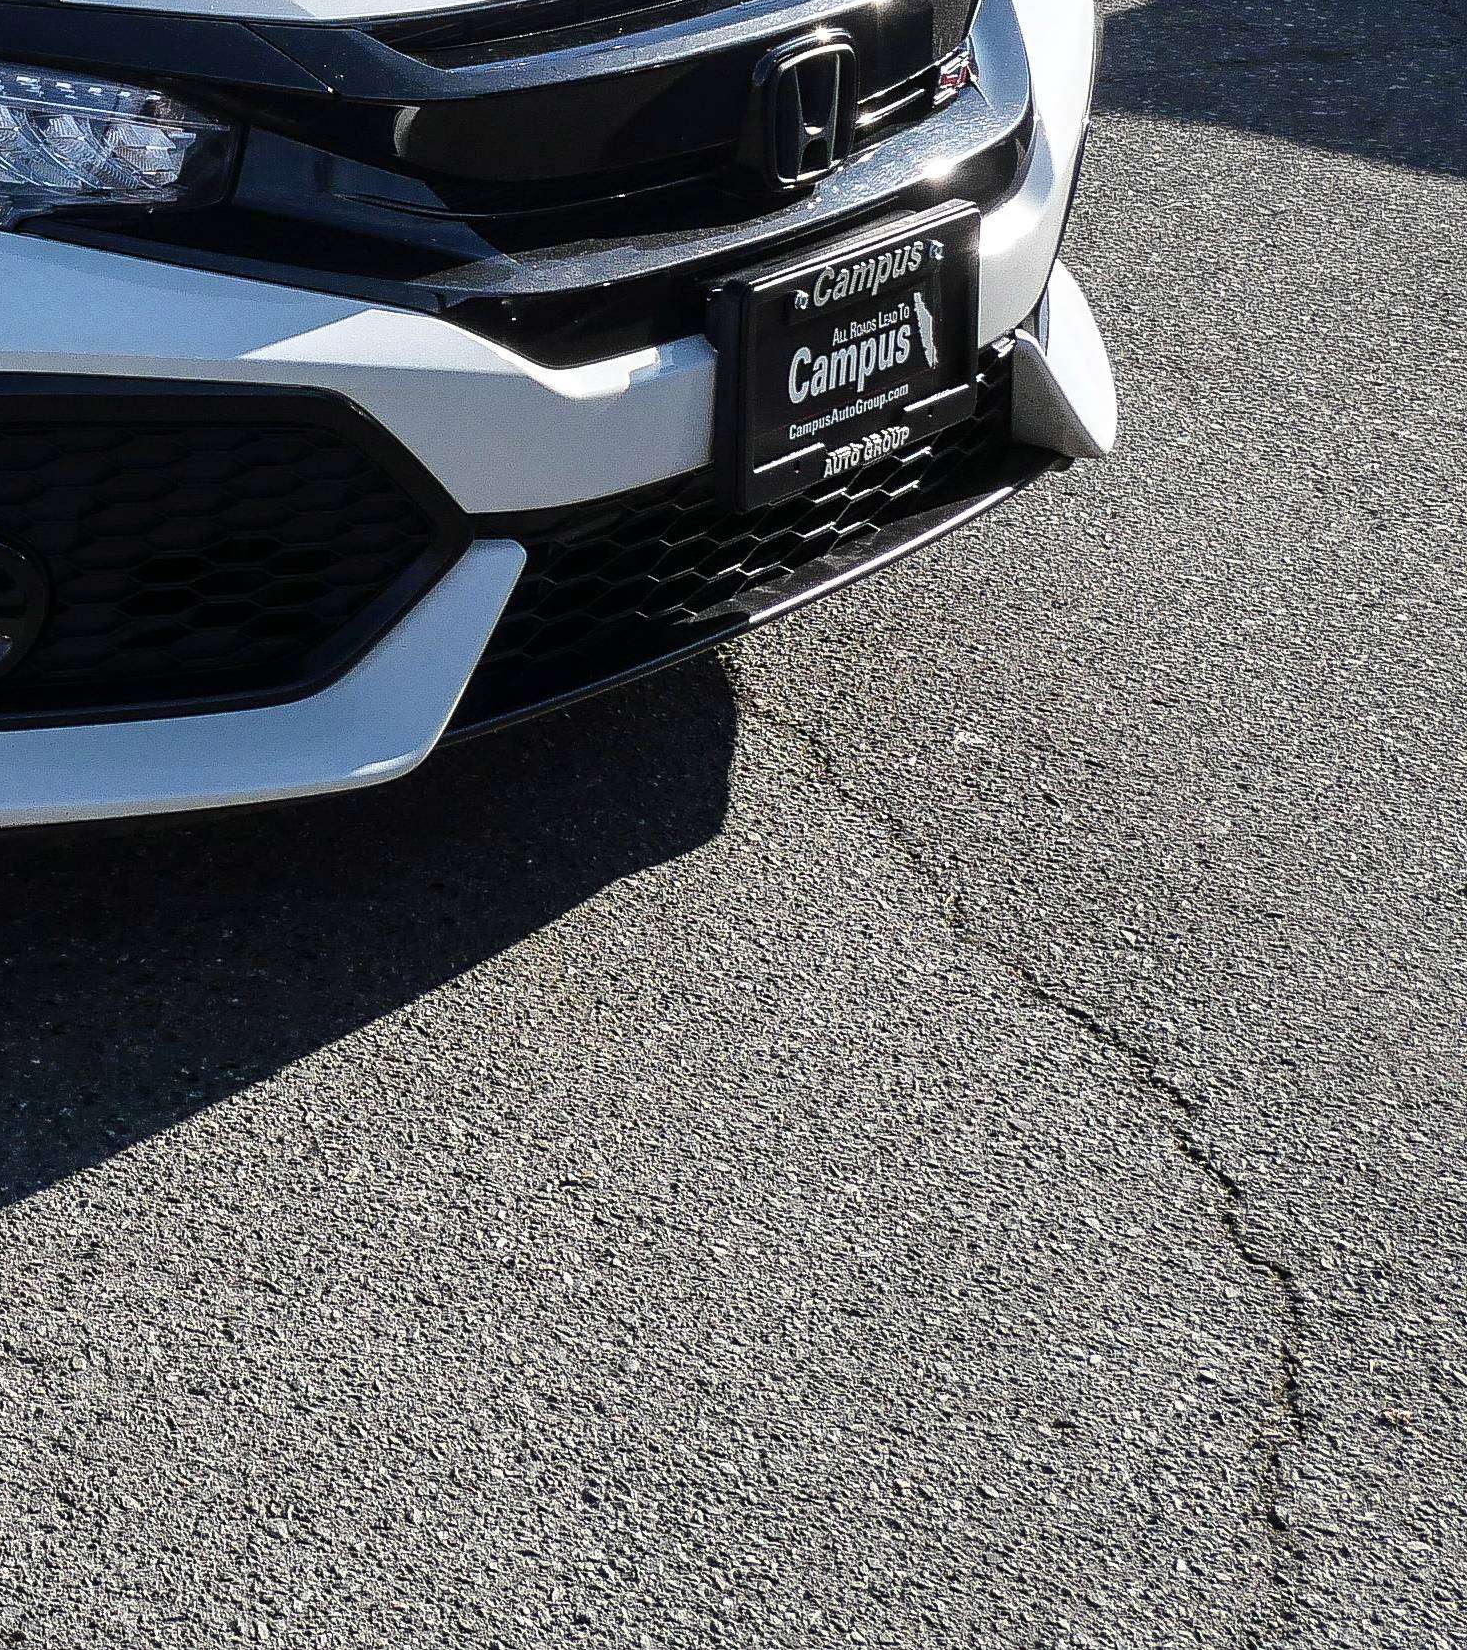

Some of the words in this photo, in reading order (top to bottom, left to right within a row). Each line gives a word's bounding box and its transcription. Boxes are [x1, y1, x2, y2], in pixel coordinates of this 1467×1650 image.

[813, 241, 924, 307] Campus
[788, 324, 912, 404] Campus
[789, 383, 910, 440] CampusAutoGroup.com
[823, 442, 864, 479] AUTO
[864, 425, 911, 460] GROUP
